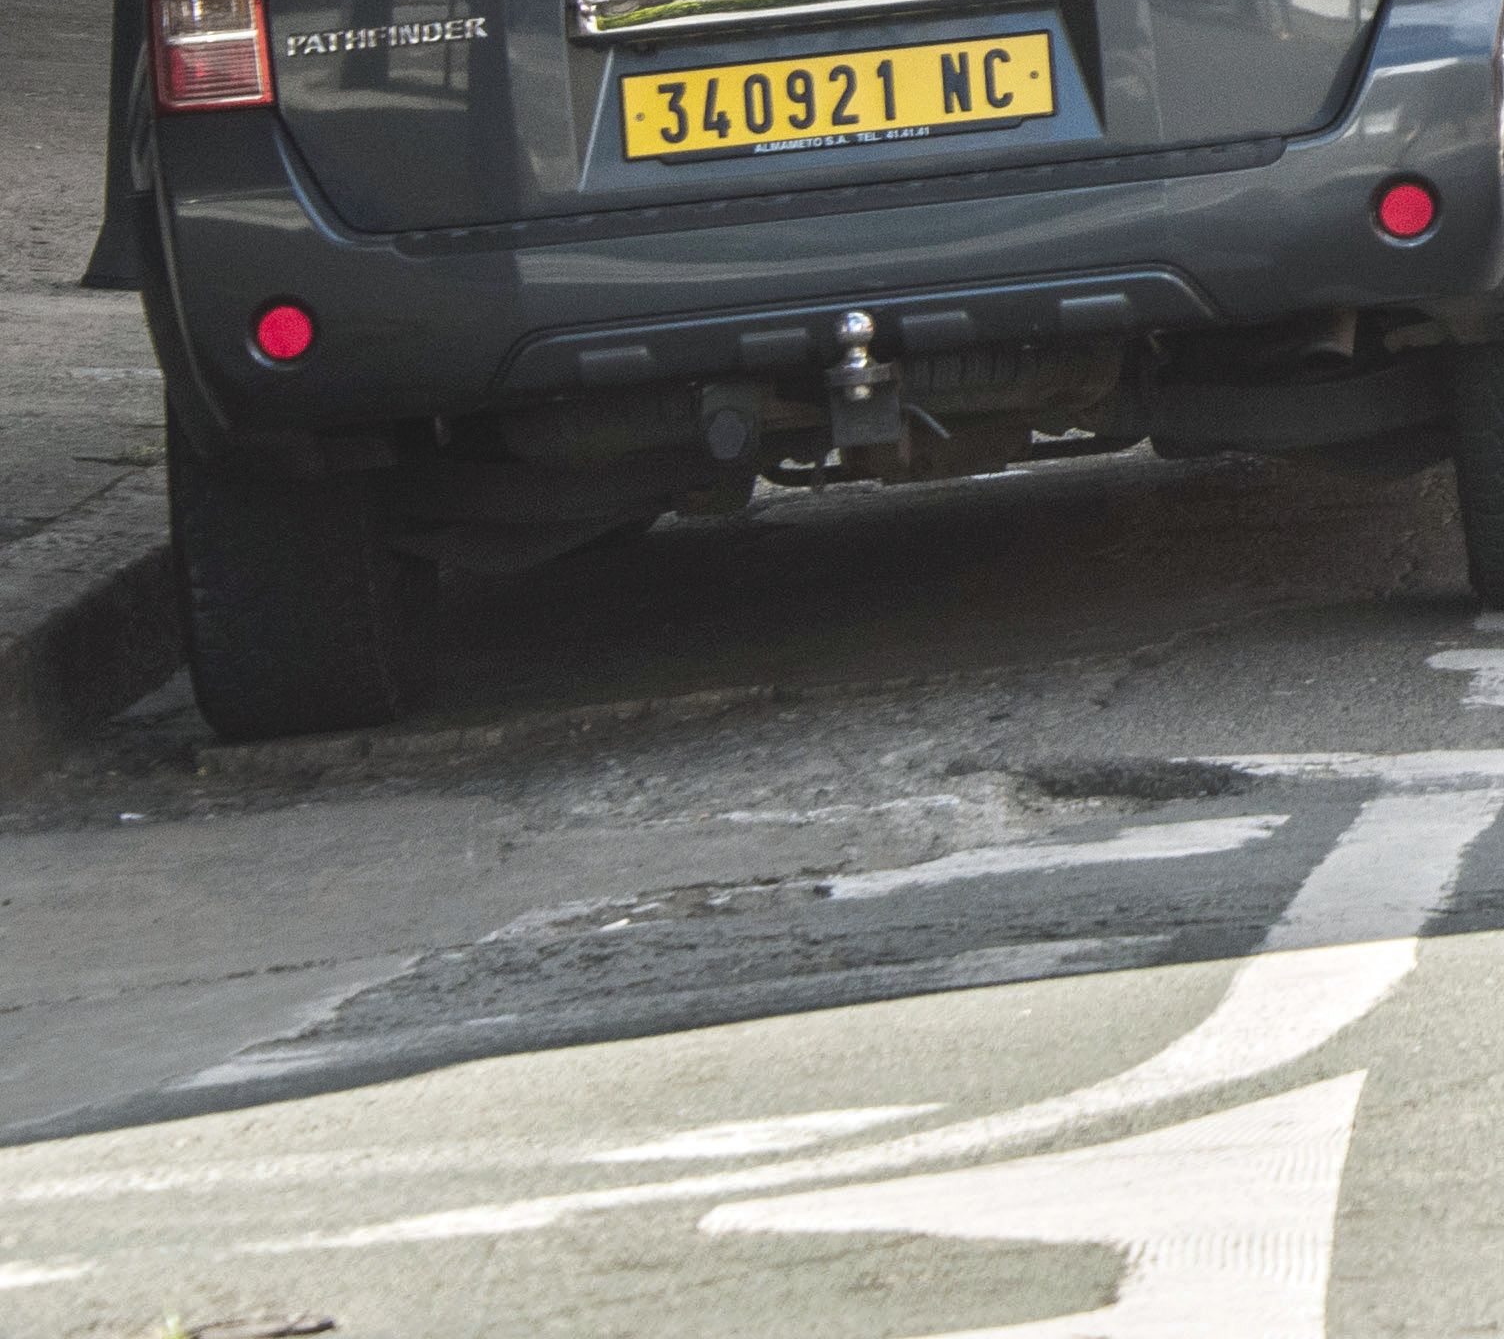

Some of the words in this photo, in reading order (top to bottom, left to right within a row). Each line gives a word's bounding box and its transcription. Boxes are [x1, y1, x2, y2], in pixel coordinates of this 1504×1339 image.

[287, 17, 488, 57] PATHFINDER
[657, 59, 897, 144] 340921
[939, 48, 1015, 115] NC
